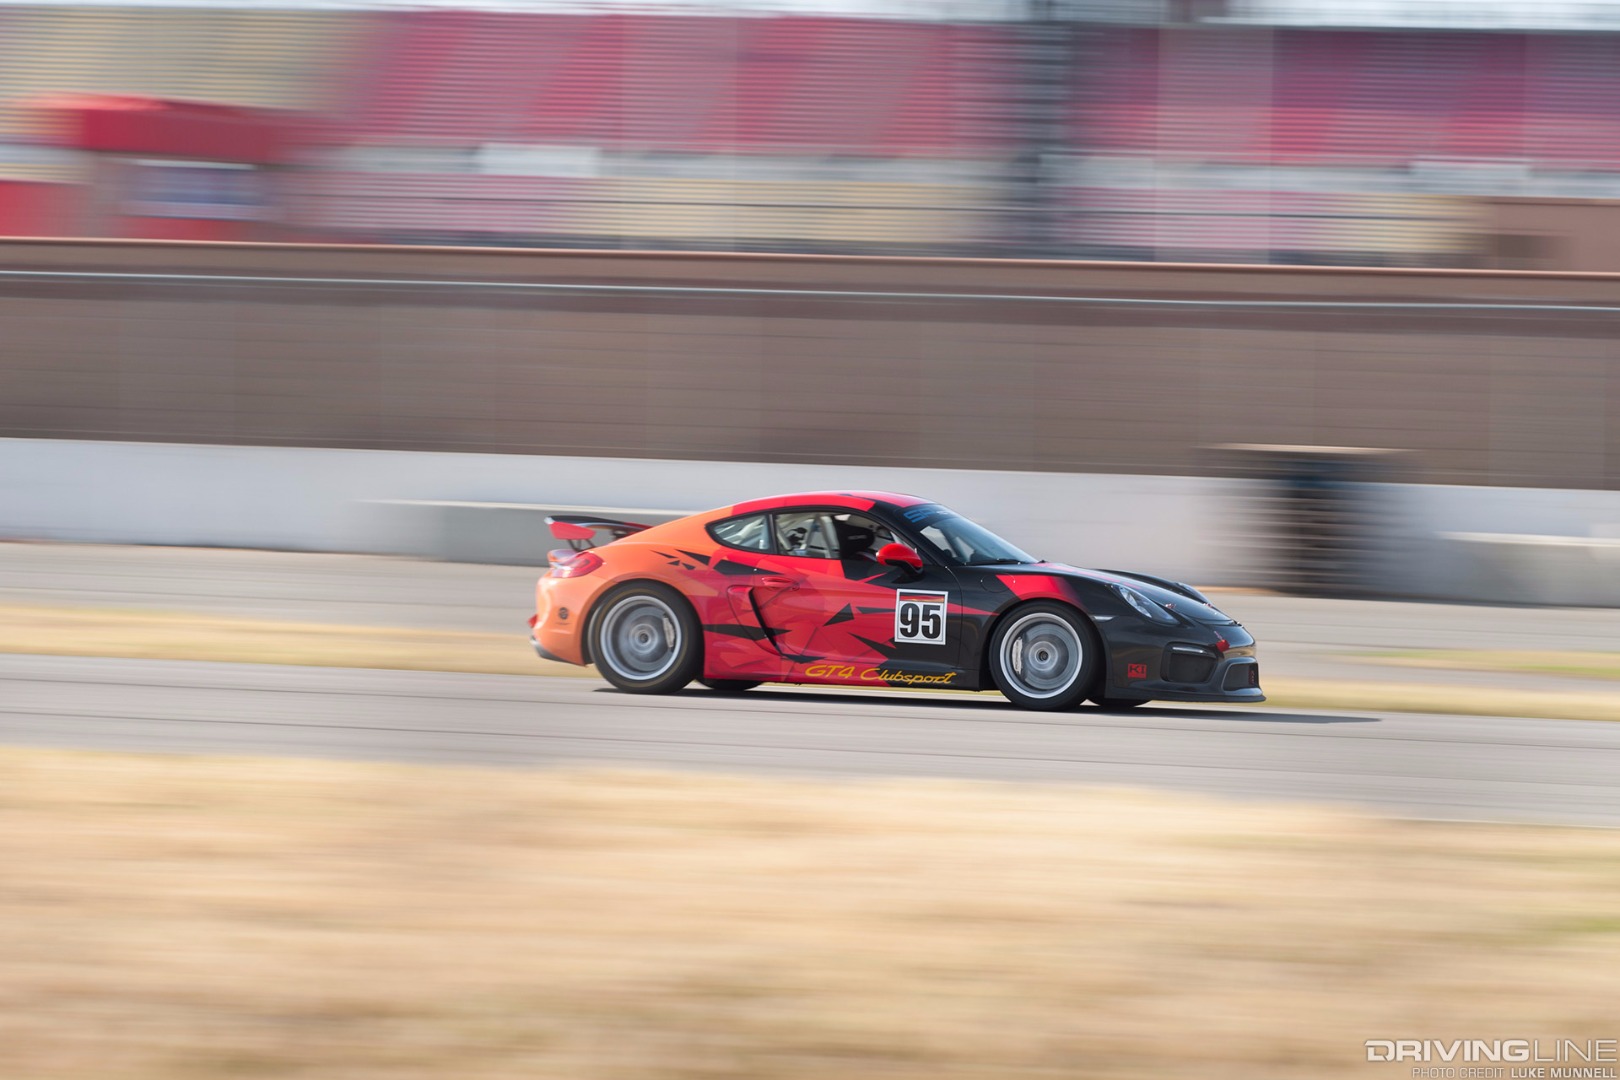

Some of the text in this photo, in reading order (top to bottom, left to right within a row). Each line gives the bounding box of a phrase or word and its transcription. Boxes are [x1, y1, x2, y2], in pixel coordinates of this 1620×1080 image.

[900, 602, 941, 639] 95
[805, 664, 957, 685] GT4 Clubsport
